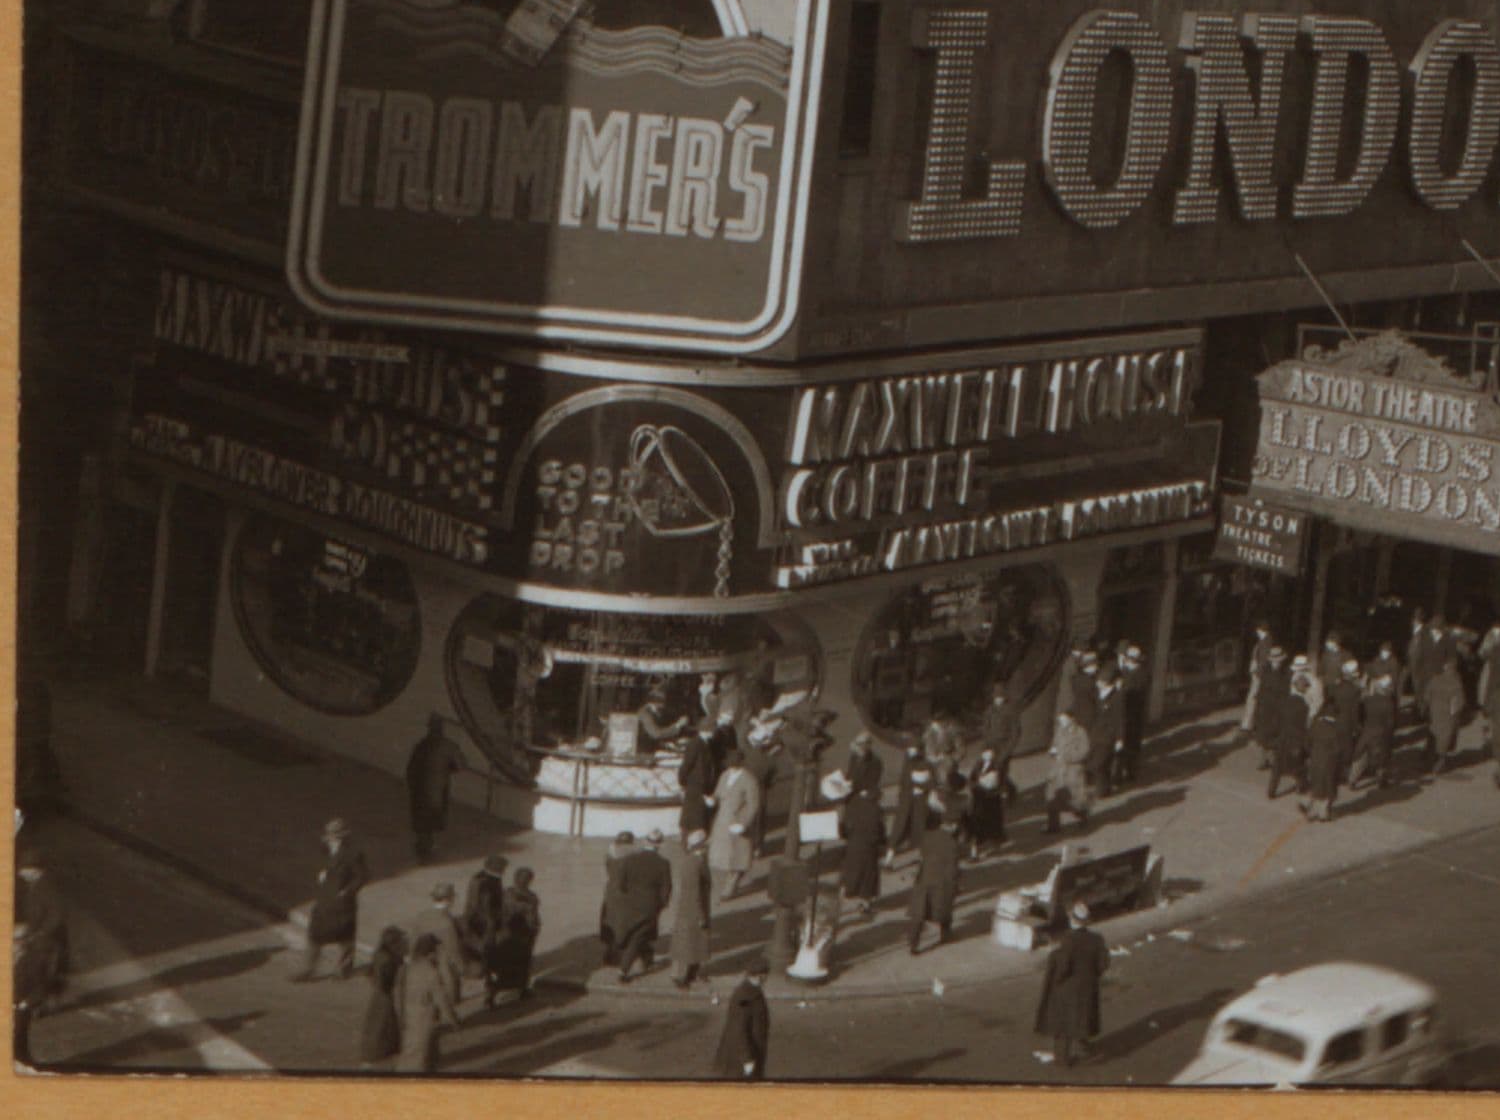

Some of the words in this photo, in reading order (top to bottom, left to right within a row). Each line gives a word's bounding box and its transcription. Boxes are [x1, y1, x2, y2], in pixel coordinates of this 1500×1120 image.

[337, 86, 775, 243] TROMMER'S
[1287, 367, 1366, 413] ASTOR
[1372, 382, 1480, 432] THEATRE
[1268, 407, 1493, 484] LLOYDS
[537, 458, 646, 492] GOOD
[785, 446, 990, 528] COFFEE
[535, 484, 580, 515] TO
[590, 492, 660, 524] THE
[1233, 503, 1299, 536] TYSON
[532, 513, 626, 546] LAST
[1222, 521, 1273, 548] THEATRE
[528, 539, 626, 576] DROP
